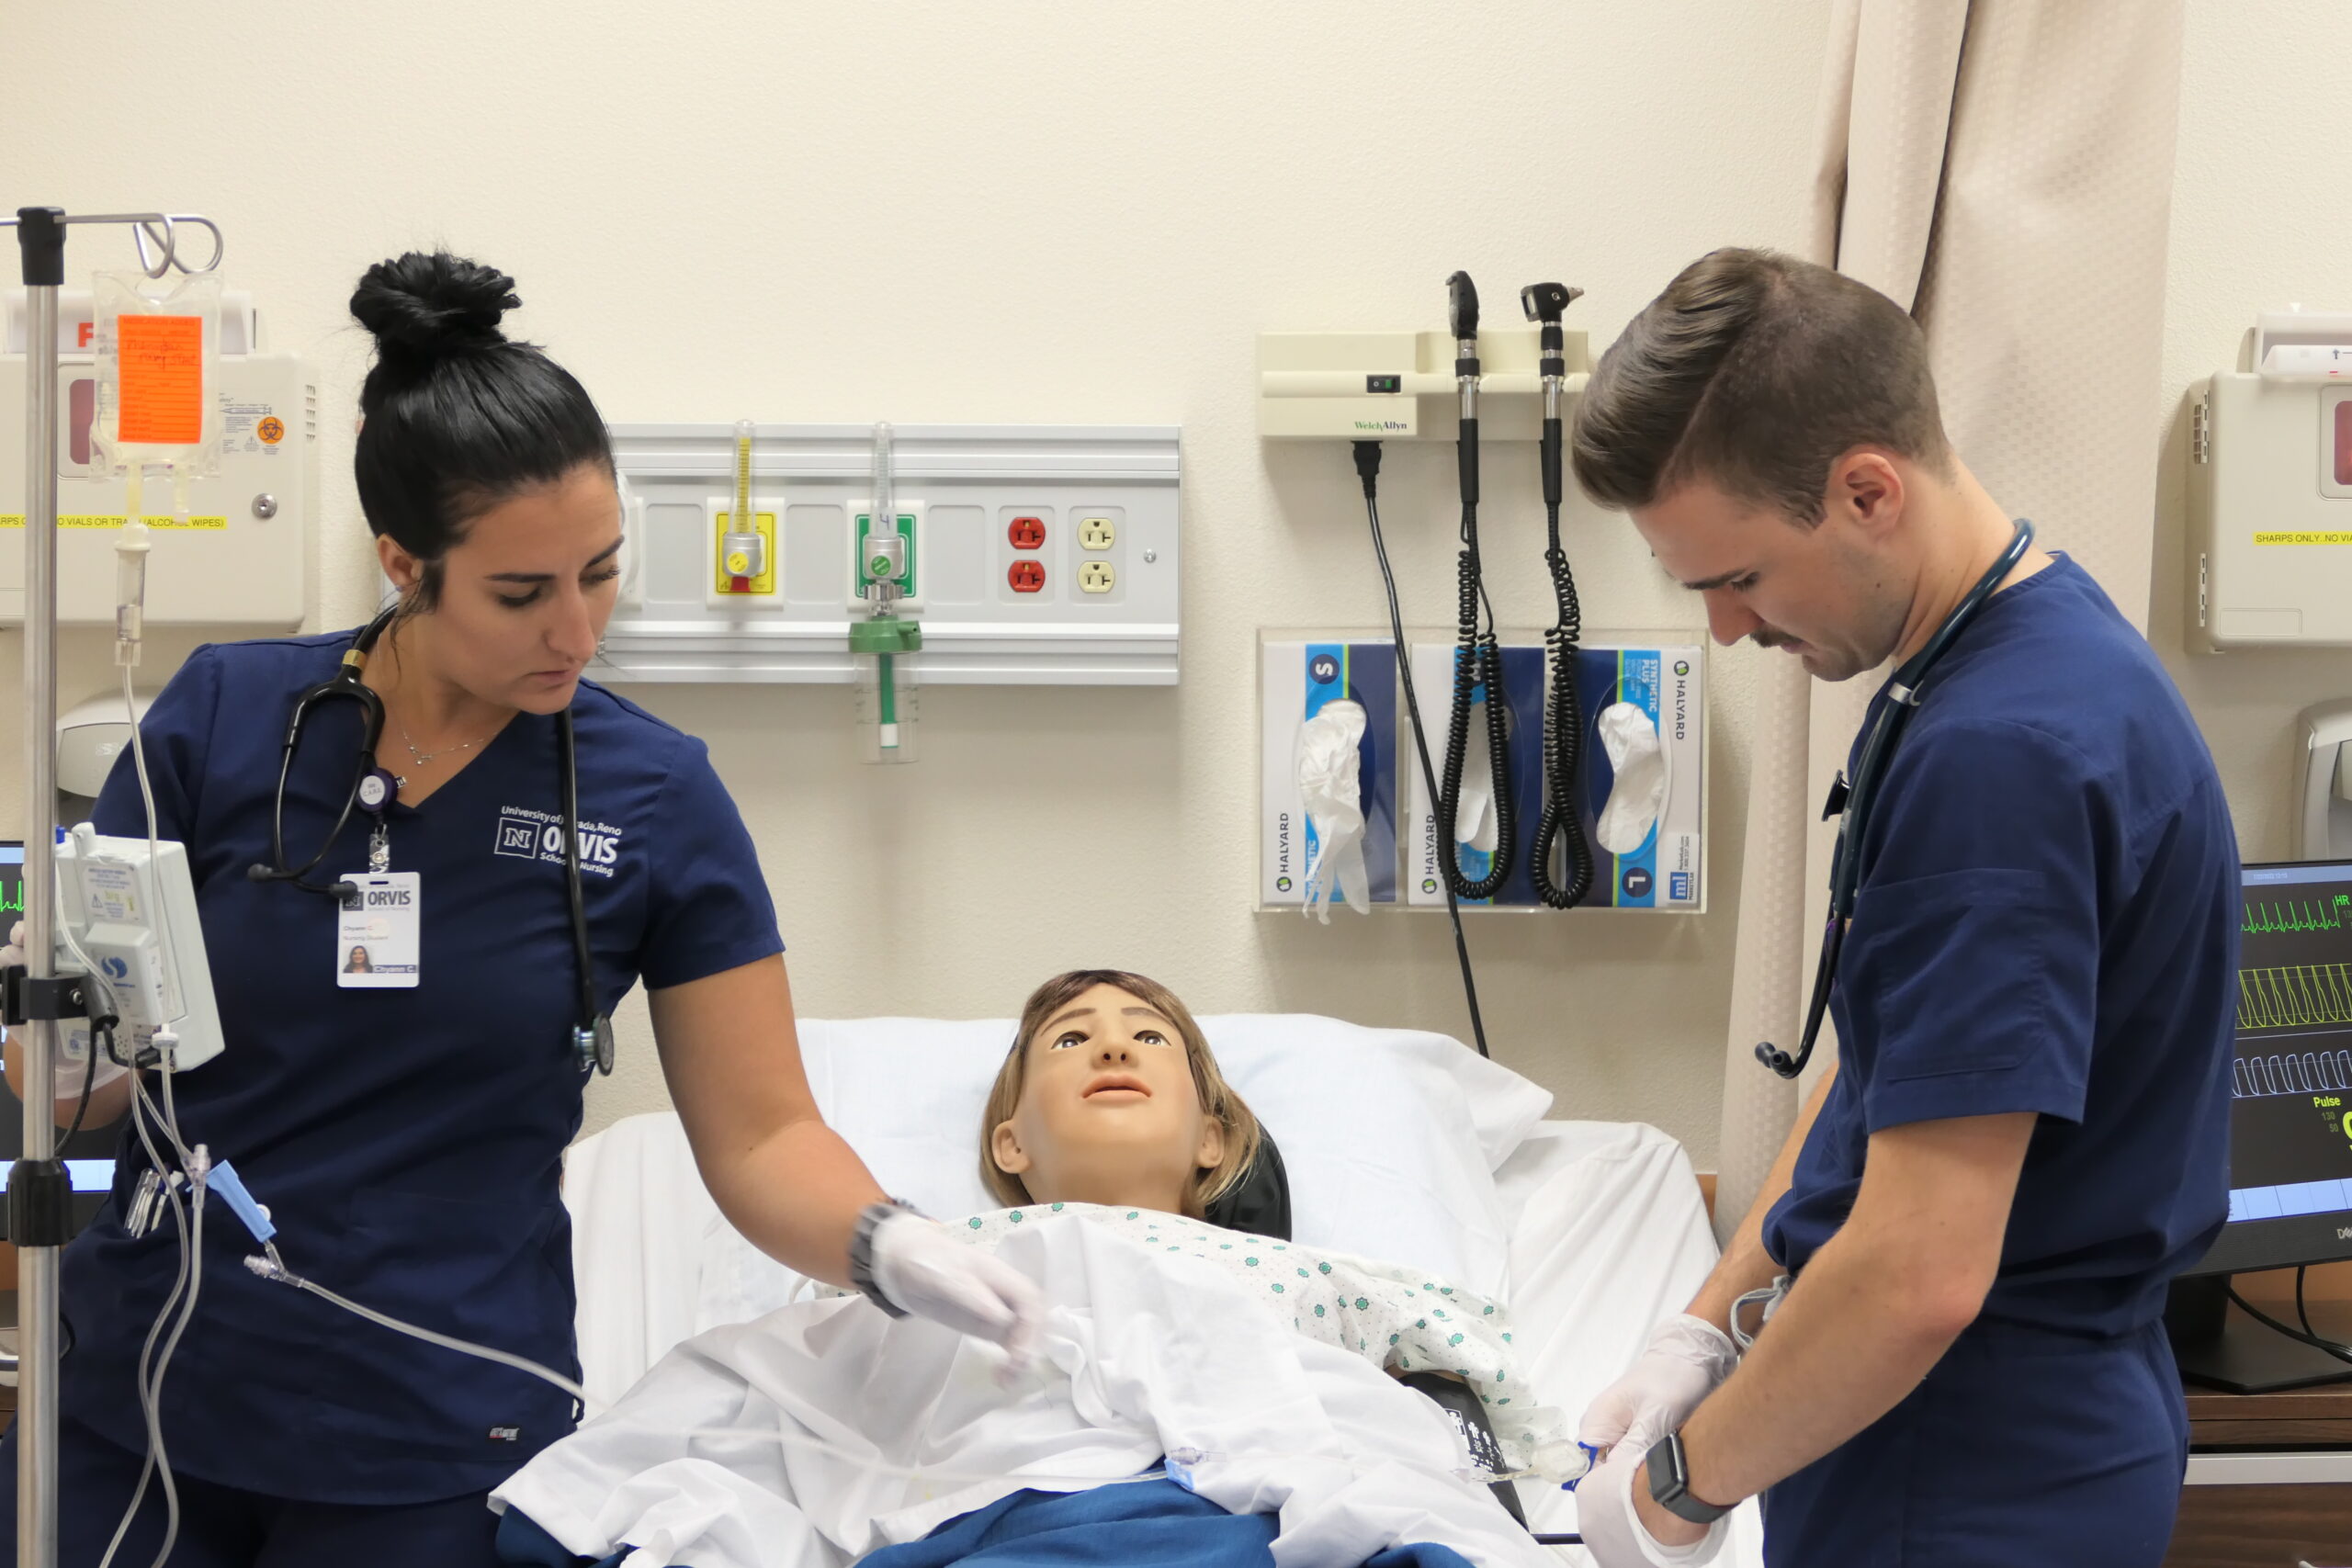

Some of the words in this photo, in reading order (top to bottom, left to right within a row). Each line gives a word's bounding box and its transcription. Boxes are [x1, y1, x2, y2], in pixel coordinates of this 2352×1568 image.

[0, 517, 19, 525] RPS
[66, 518, 93, 526] VIALS
[95, 518, 108, 526] OR
[192, 519, 224, 527] WIPES)
[879, 512, 890, 531] 4
[2256, 534, 2294, 543] SHARPS
[1315, 662, 1333, 676] S
[1642, 660, 1650, 683] PLUS
[1649, 660, 1658, 713] SYNTHETIC
[1676, 680, 1686, 740] HALYARD
[501, 805, 549, 823] University
[549, 814, 561, 823] of
[597, 822, 622, 836] Reno
[503, 827, 532, 849] N
[1280, 813, 1289, 873] HALYARD
[1424, 814, 1435, 874] HALYARD
[539, 852, 567, 866] Schoo
[579, 862, 615, 877] Nursing
[1628, 876, 1646, 889] L
[368, 890, 411, 905] ORVIS
[2335, 895, 2350, 906] HR
[2312, 1096, 2341, 1108] Pulse
[2321, 1111, 2335, 1122] 130
